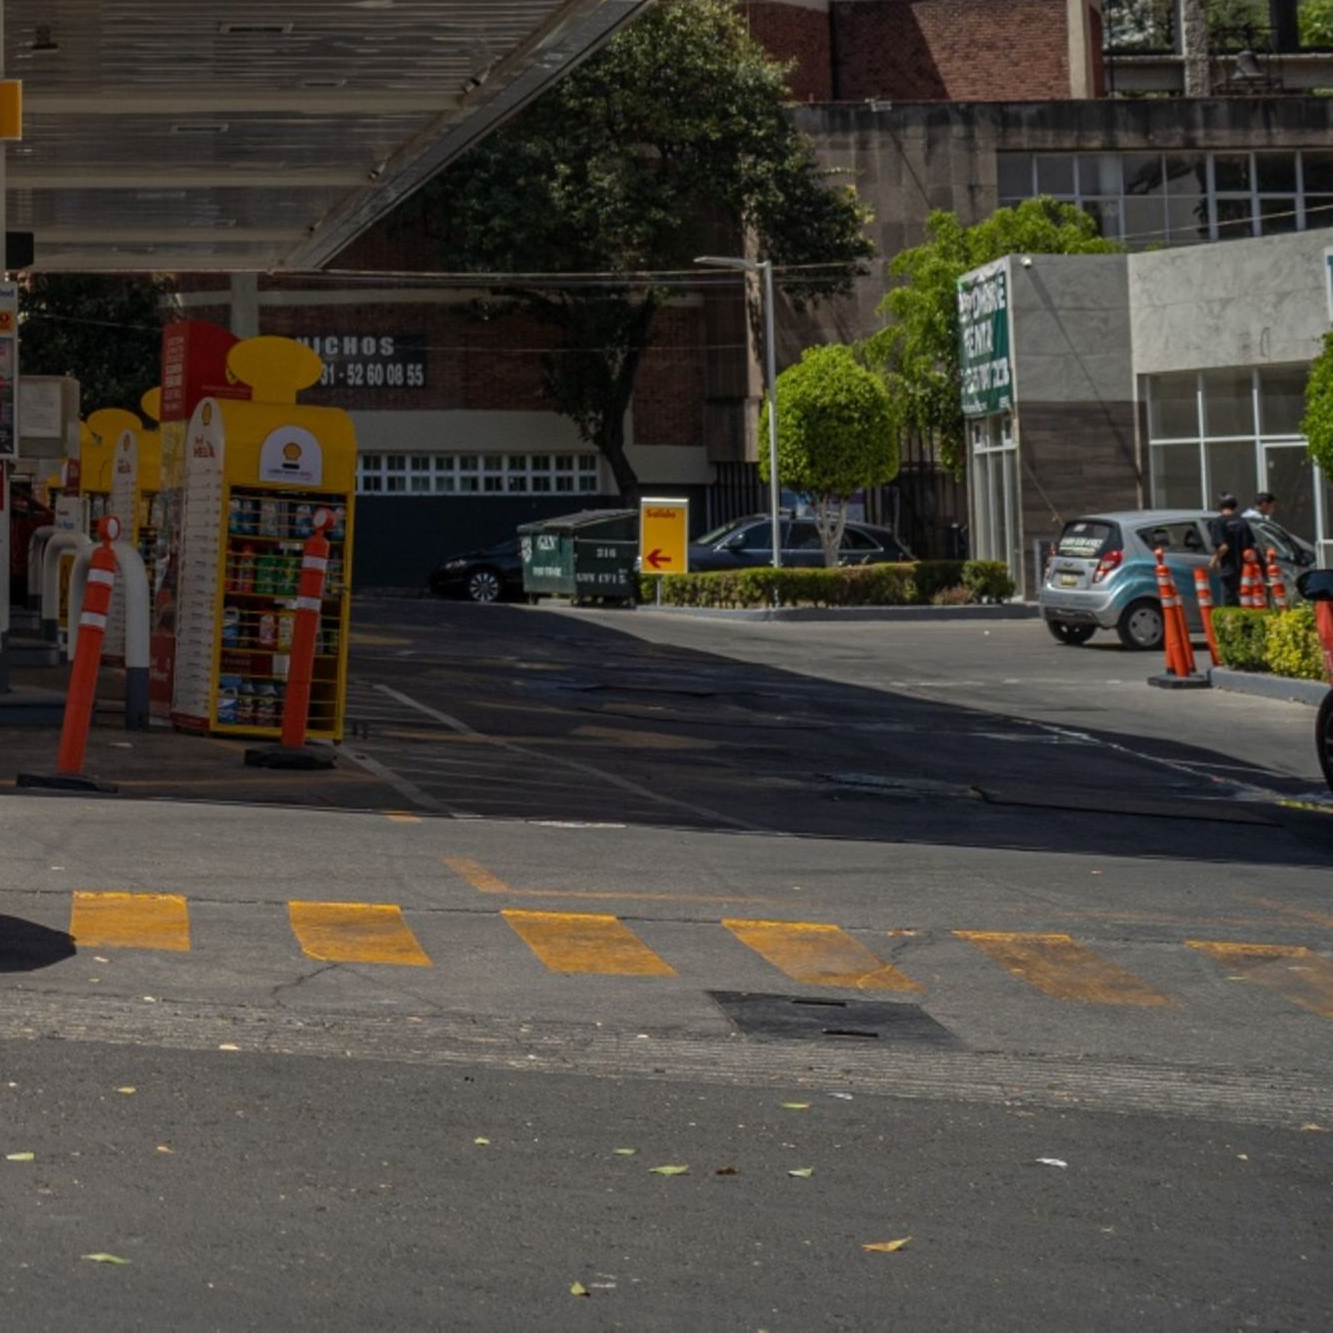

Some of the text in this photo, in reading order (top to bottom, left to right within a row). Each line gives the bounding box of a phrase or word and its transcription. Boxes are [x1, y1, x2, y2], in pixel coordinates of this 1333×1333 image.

[347, 363, 364, 386] 52
[366, 363, 385, 387] 60
[386, 363, 405, 387] 08
[406, 363, 424, 387] 55
[646, 508, 676, 518] Salida
